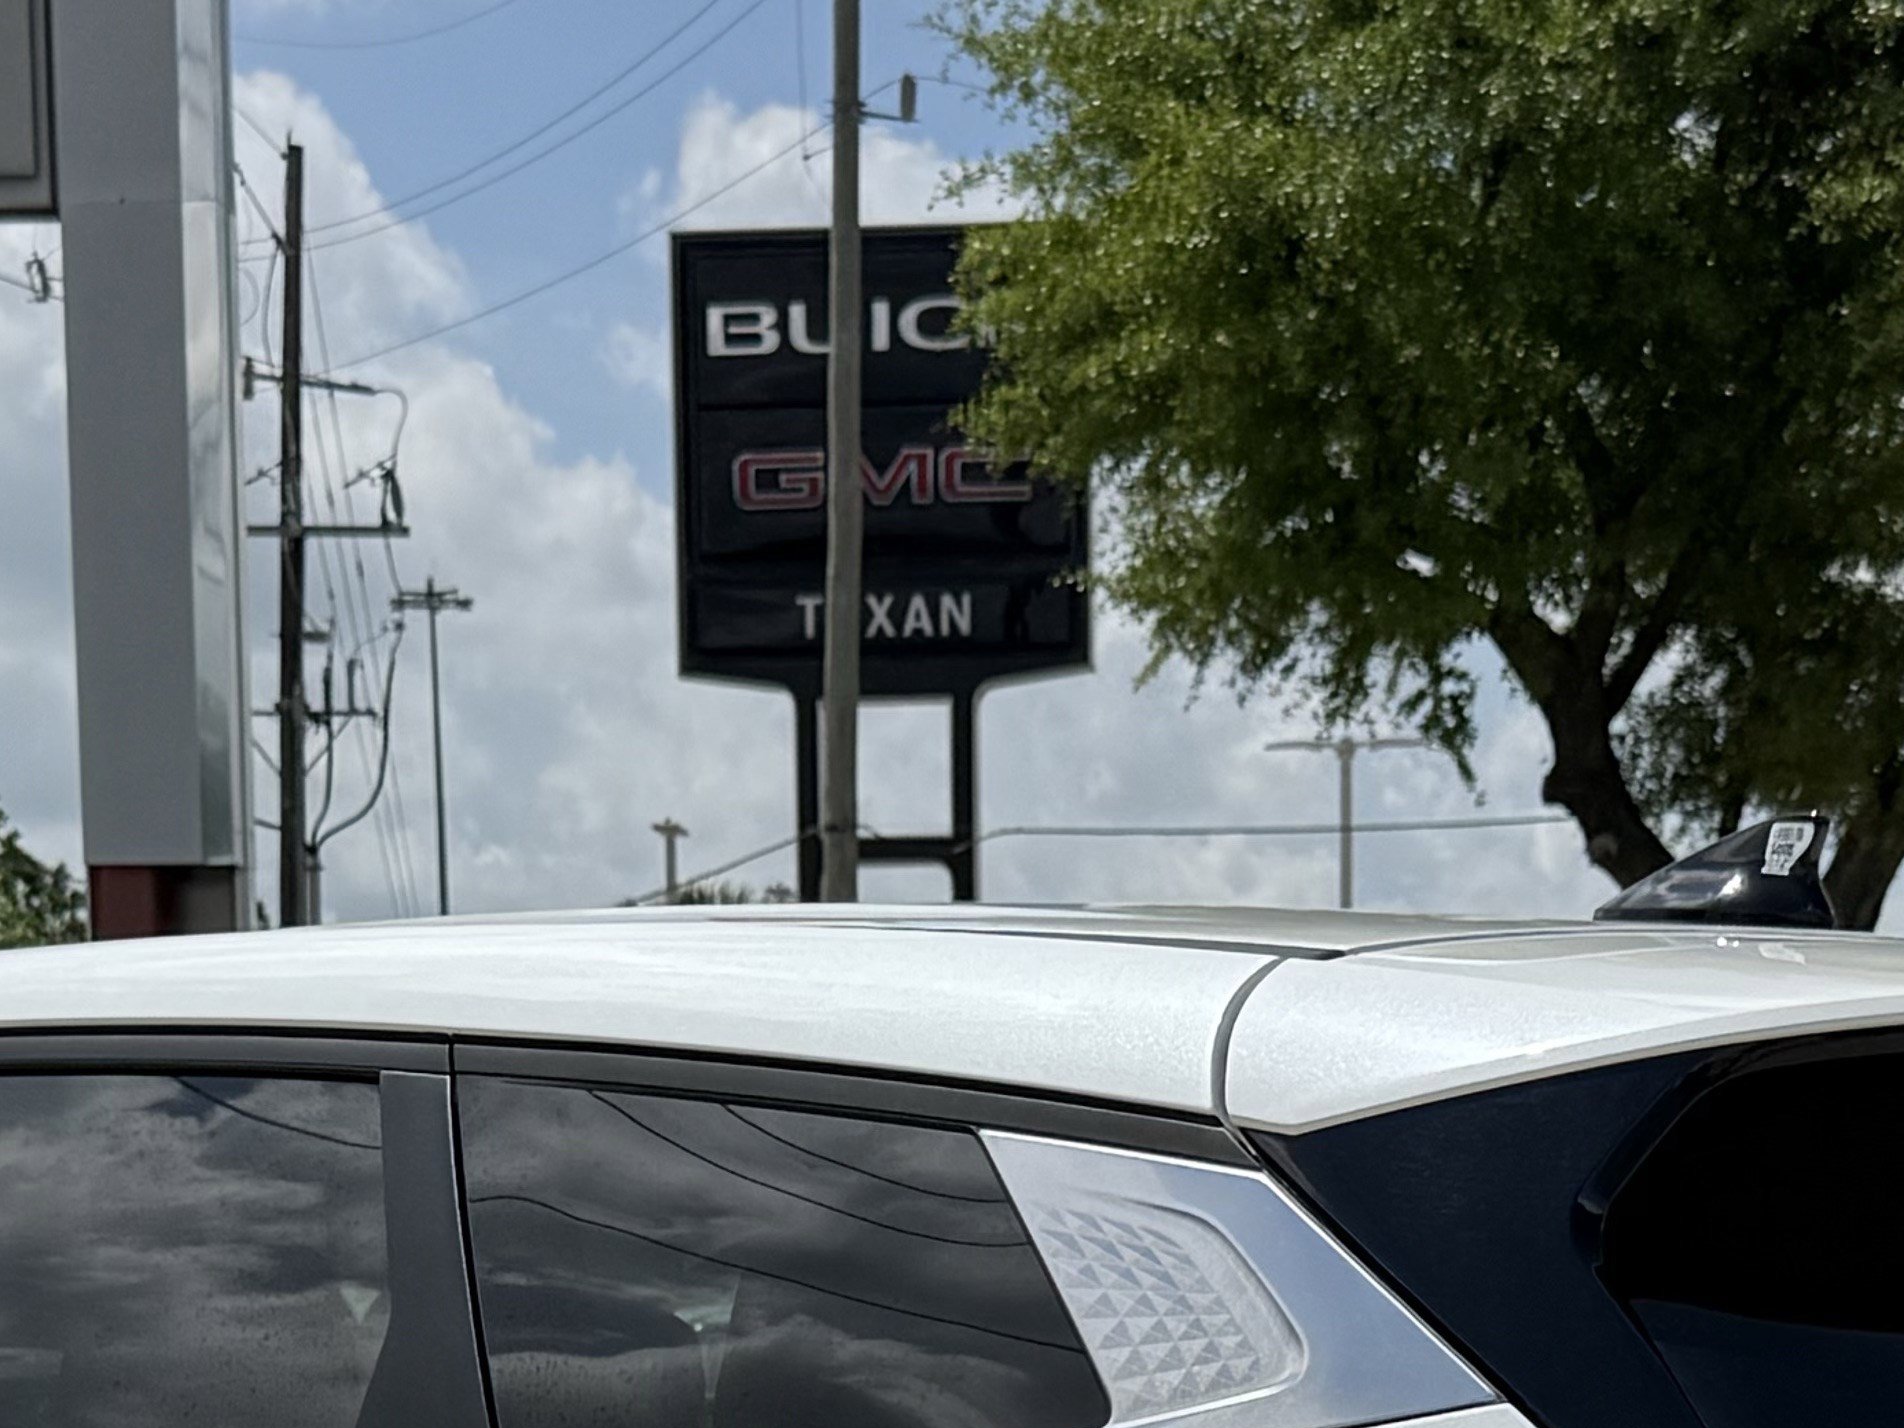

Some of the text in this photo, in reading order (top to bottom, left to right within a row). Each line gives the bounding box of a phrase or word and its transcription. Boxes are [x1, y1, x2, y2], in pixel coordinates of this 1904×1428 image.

[704, 294, 999, 357] BUIC
[732, 446, 1032, 512] GMC
[796, 592, 973, 641] TXAN
